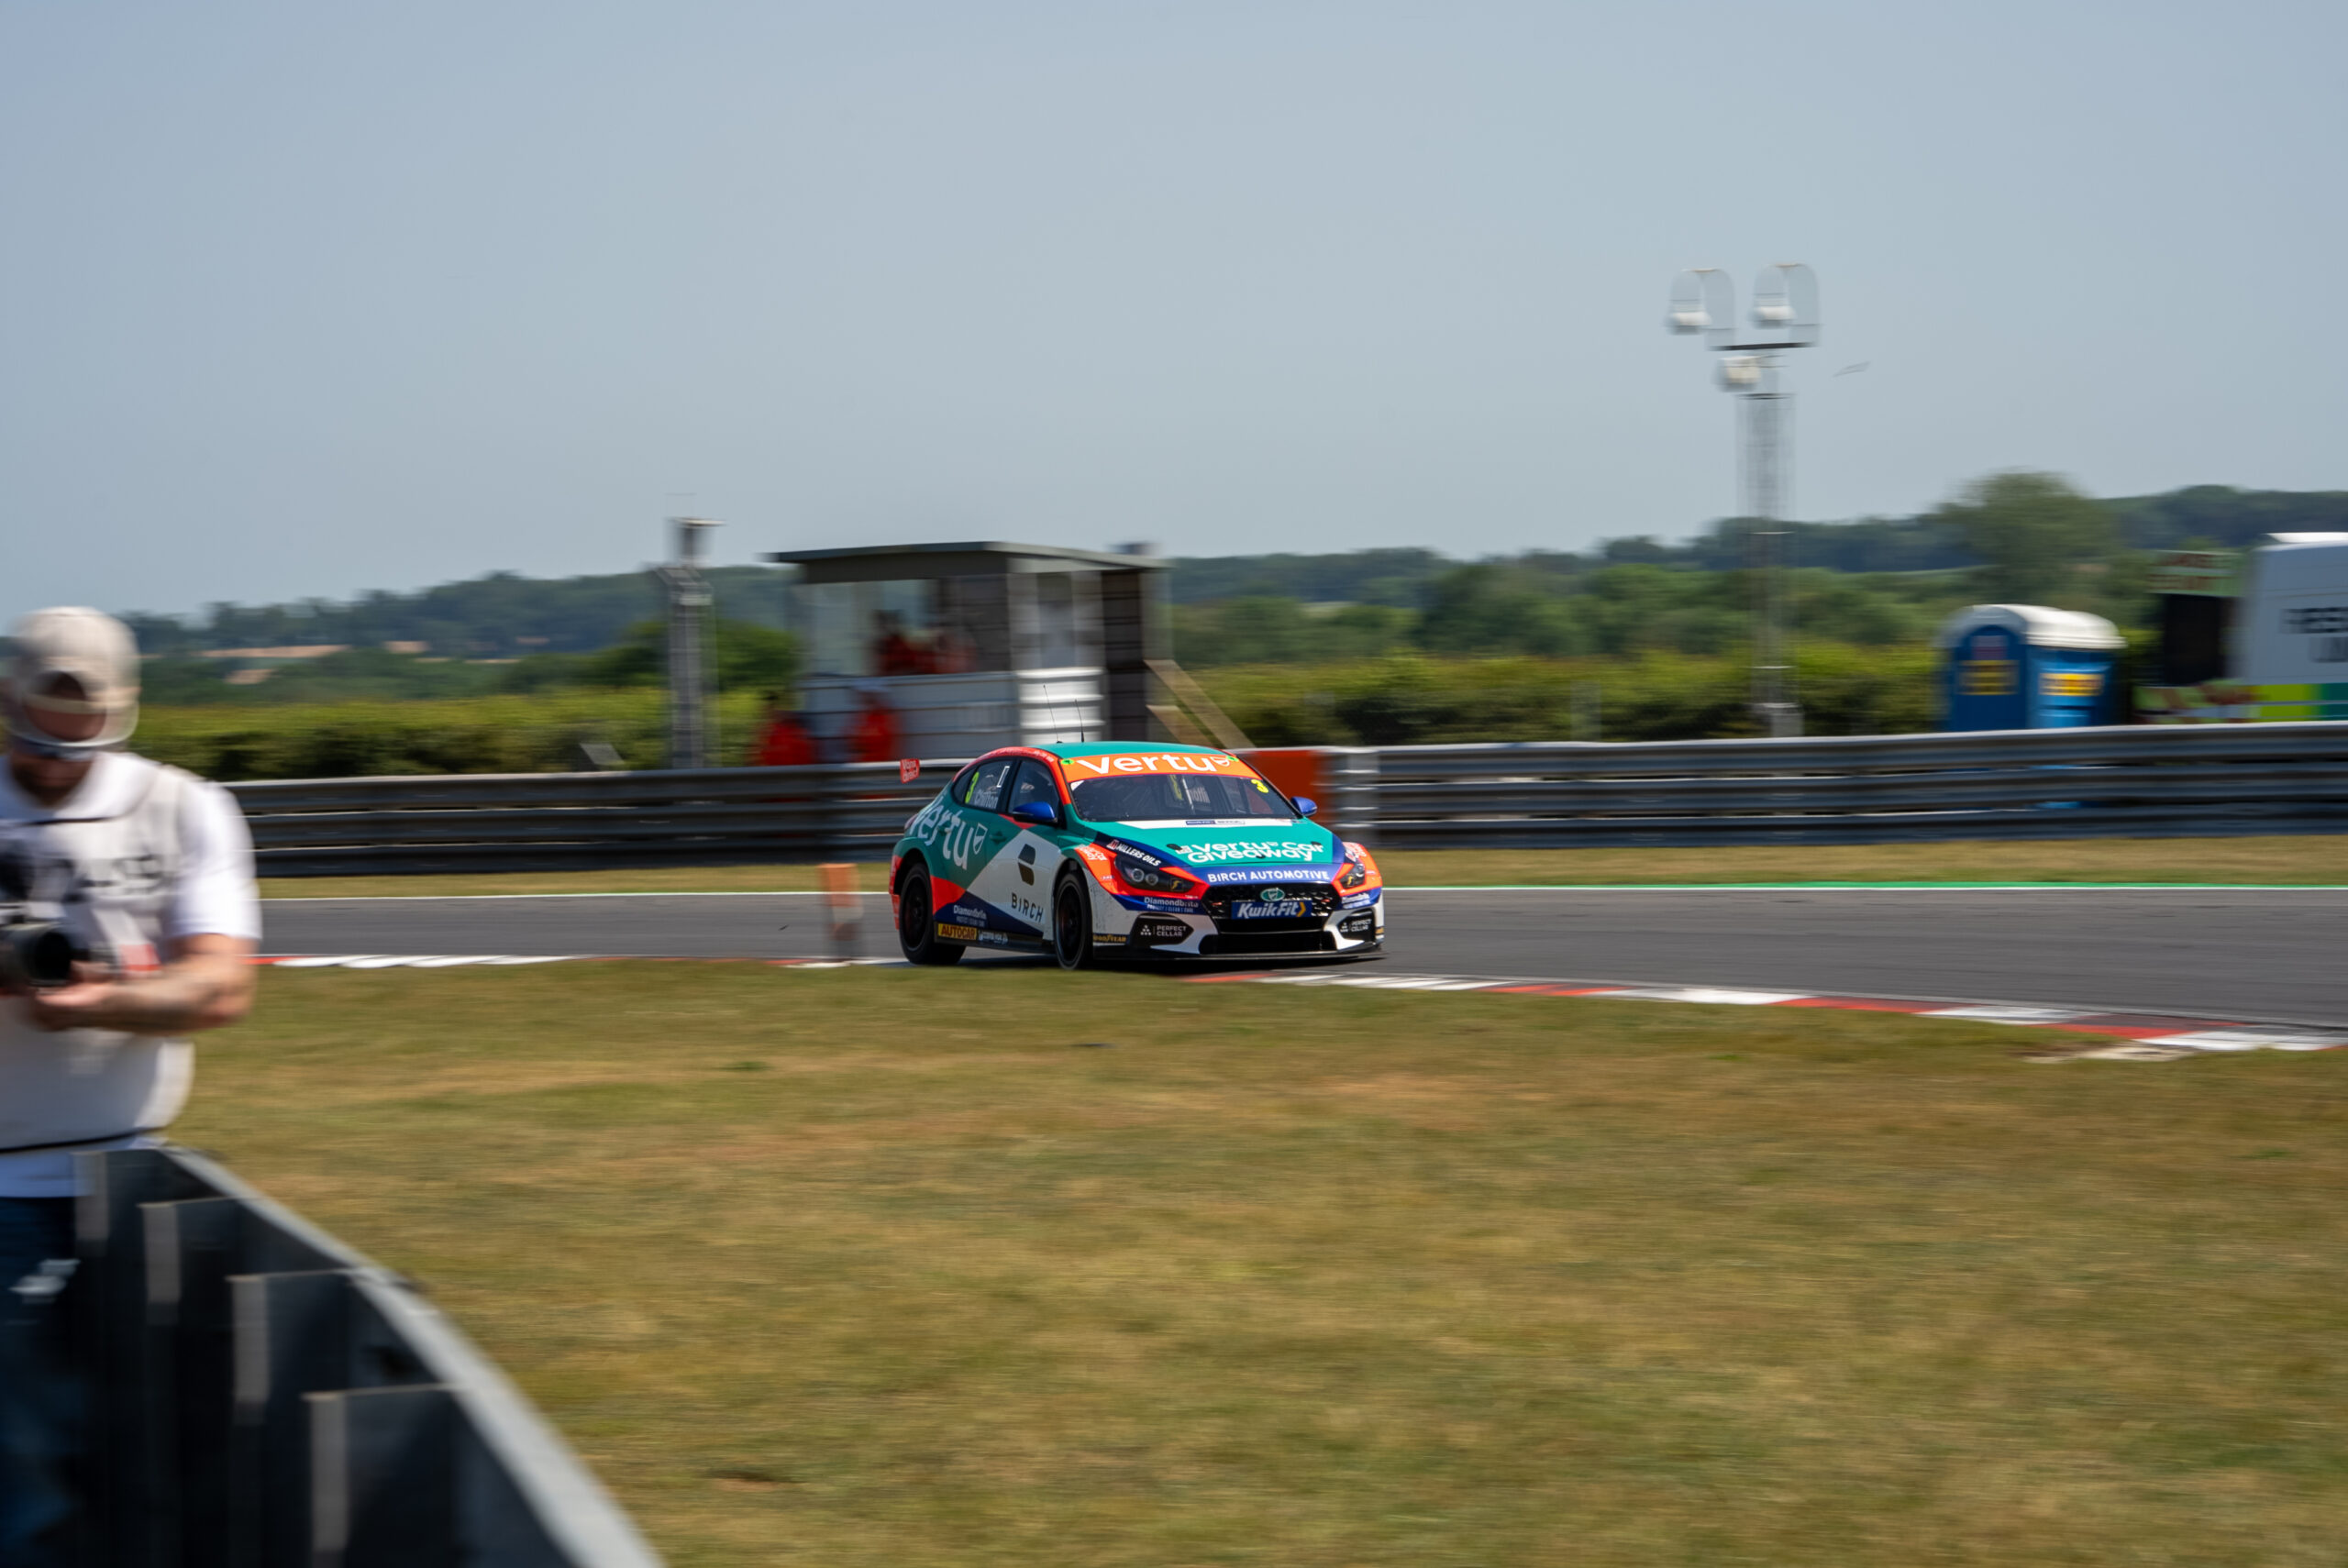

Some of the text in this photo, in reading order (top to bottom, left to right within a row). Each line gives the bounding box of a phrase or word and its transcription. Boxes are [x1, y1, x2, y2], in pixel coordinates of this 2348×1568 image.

[965, 771, 980, 803] 3
[1250, 778, 1269, 794] 3
[1116, 843, 1145, 859] MILLERS
[1142, 853, 1162, 867] OILS
[1187, 849, 1312, 863] Giveaway
[1208, 870, 1330, 883] BIRCH AUTOMOTIVE
[1011, 891, 1045, 923] BIRCH
[940, 925, 977, 941] AUTOCAR
